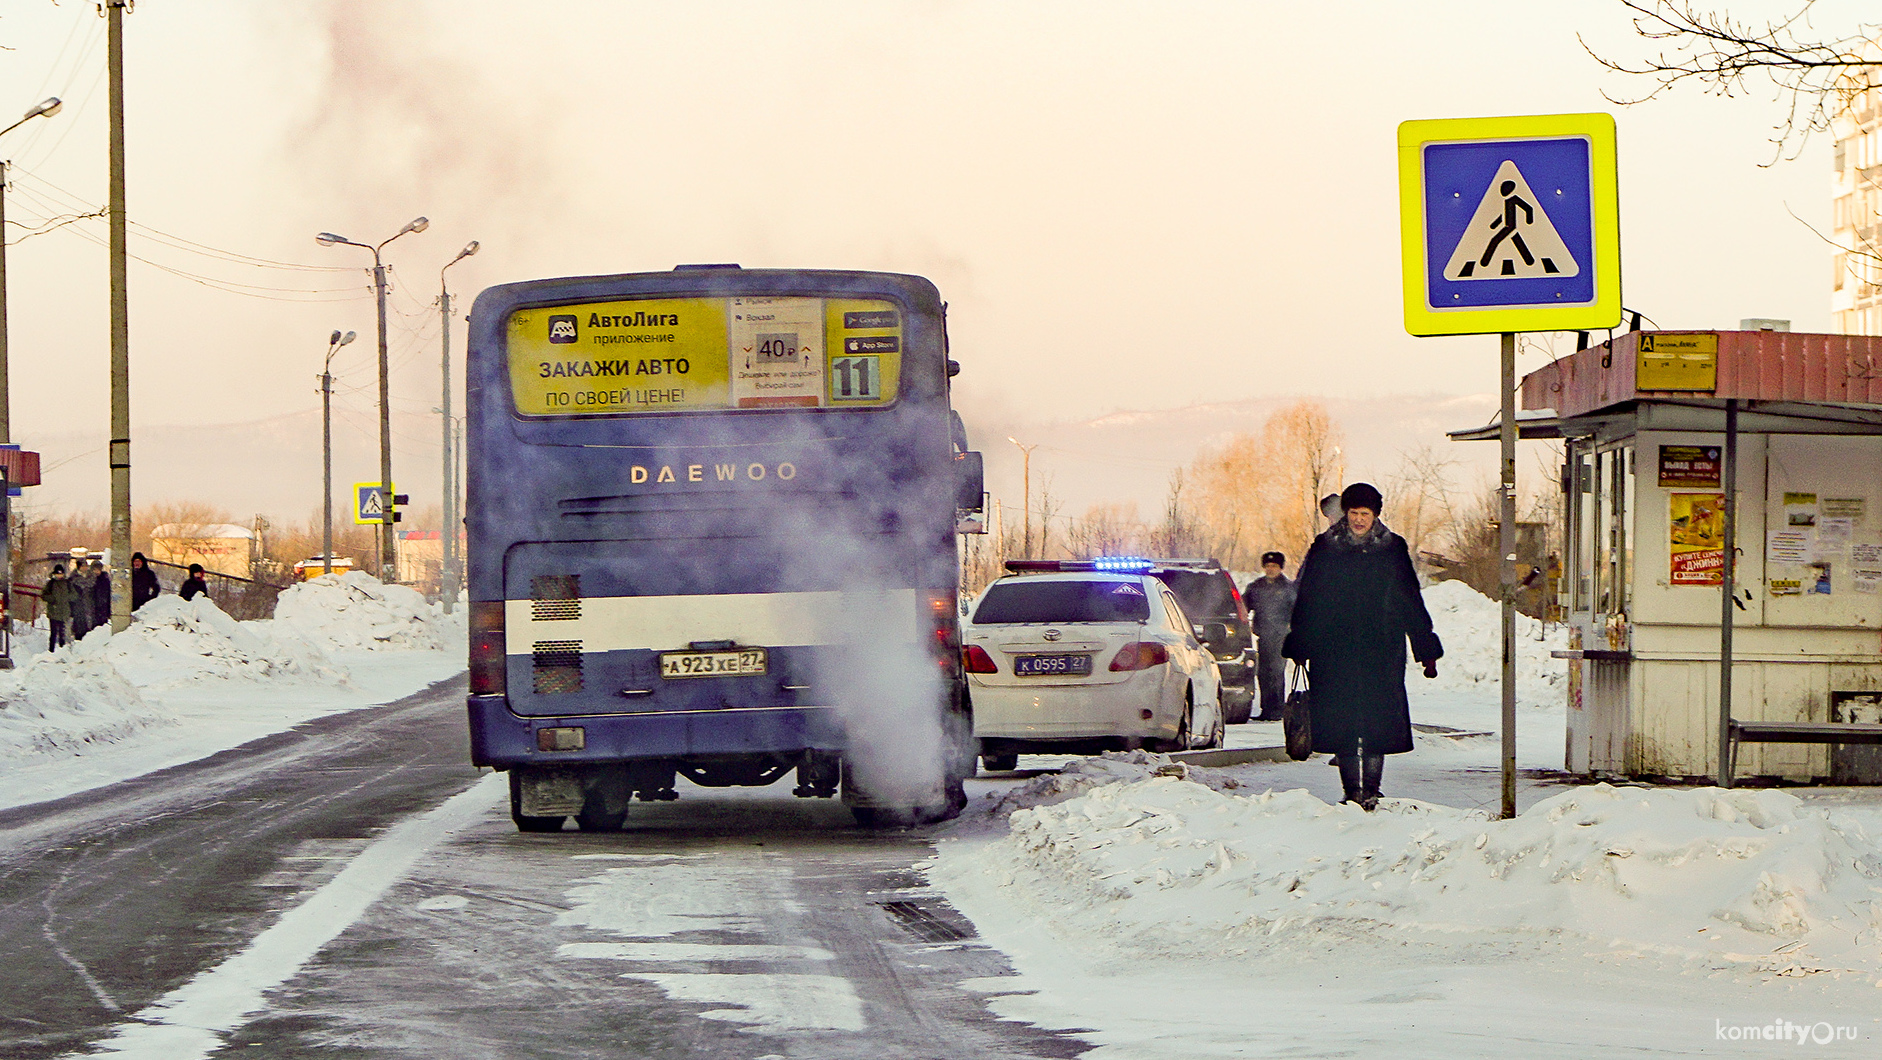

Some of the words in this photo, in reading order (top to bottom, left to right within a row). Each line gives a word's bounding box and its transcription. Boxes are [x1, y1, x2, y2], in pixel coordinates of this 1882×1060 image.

[588, 312, 679, 328] АвтоЛига
[593, 333, 675, 346] приложение
[876, 341, 894, 349] Store
[539, 360, 630, 378] ЗАКАЖИ
[635, 358, 690, 375] АВТО
[833, 358, 869, 396] 11
[546, 391, 570, 406] ПО
[575, 387, 631, 405] СВОЕЙ
[636, 388, 685, 405] ЦЕНЕ!
[630, 462, 797, 484] DAEWOO
[1033, 658, 1066, 671] 0595
